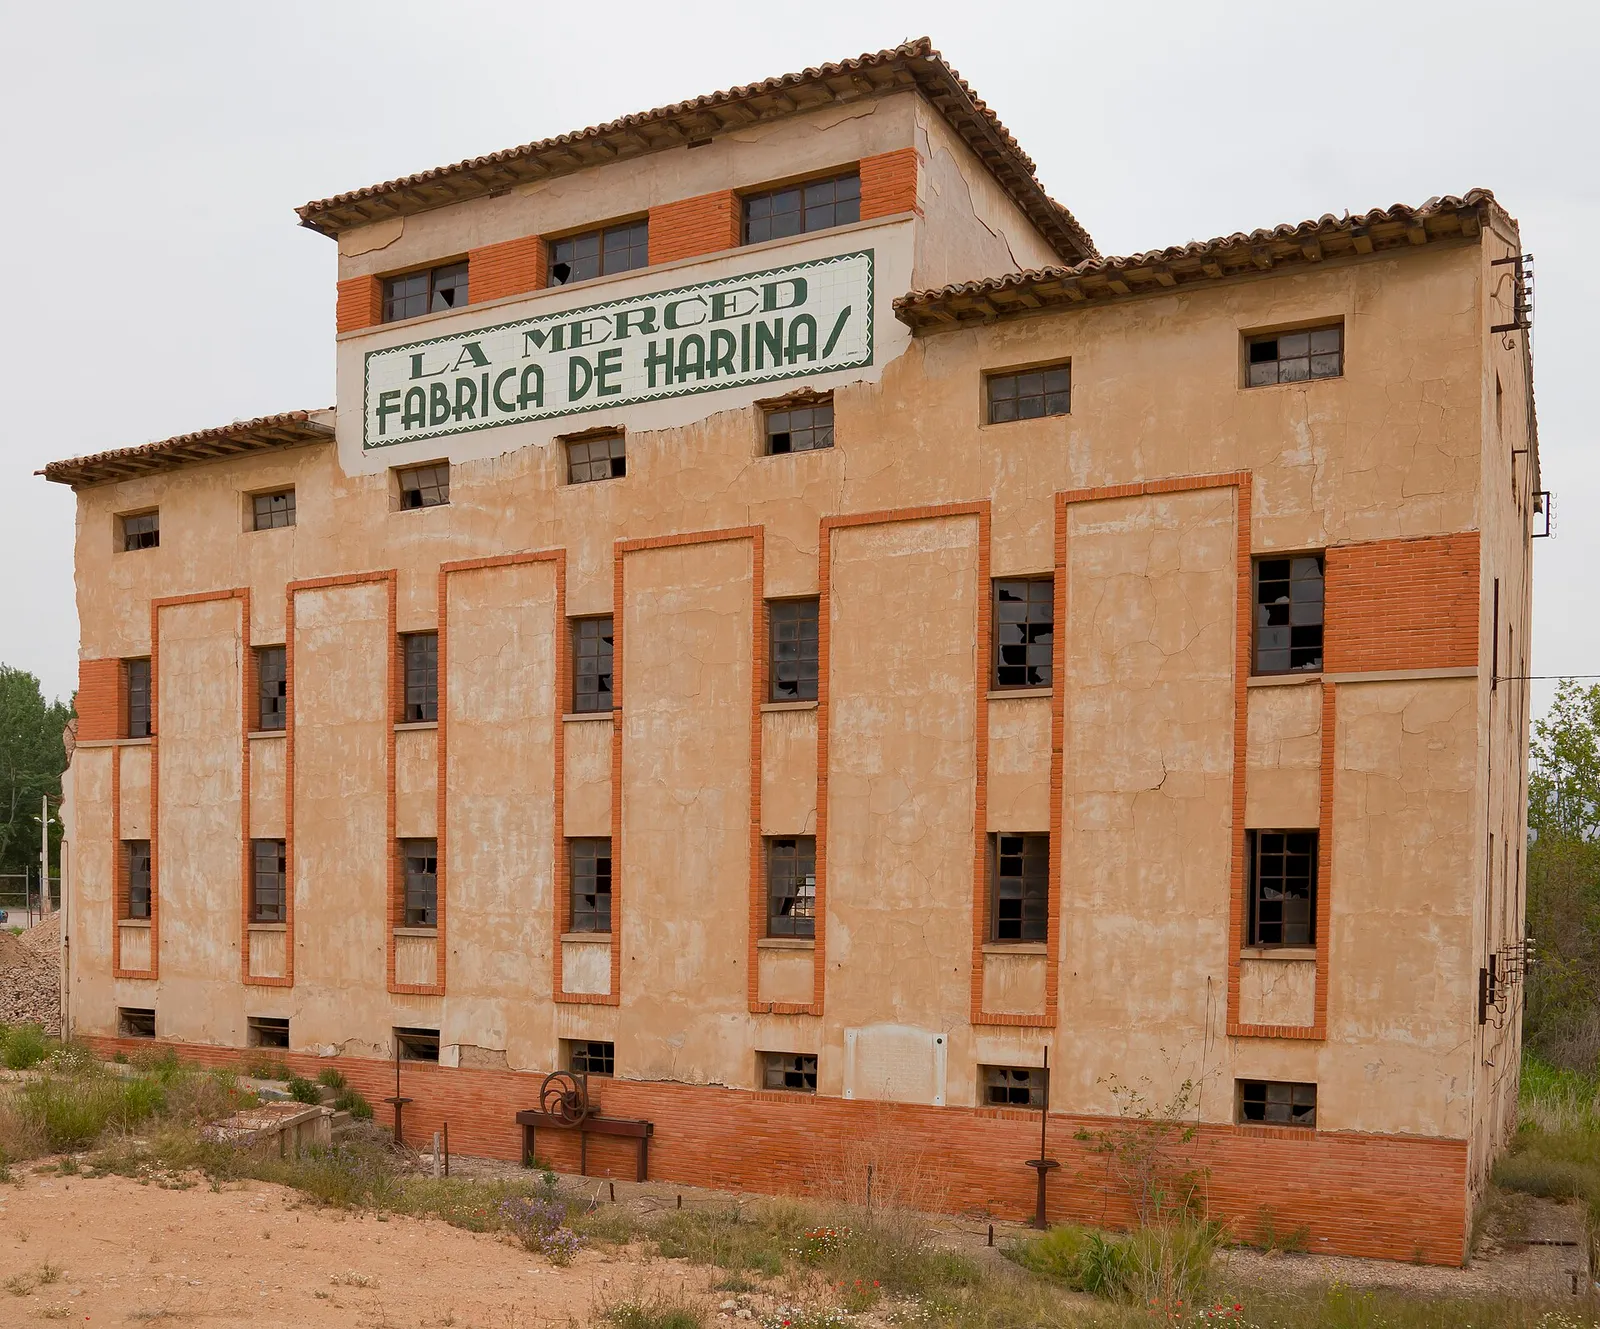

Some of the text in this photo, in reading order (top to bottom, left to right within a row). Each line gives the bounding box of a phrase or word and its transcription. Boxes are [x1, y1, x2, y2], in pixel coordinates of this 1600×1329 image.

[408, 276, 808, 380] LA MERCED
[376, 363, 544, 435] FABRICA
[569, 347, 623, 402] DE
